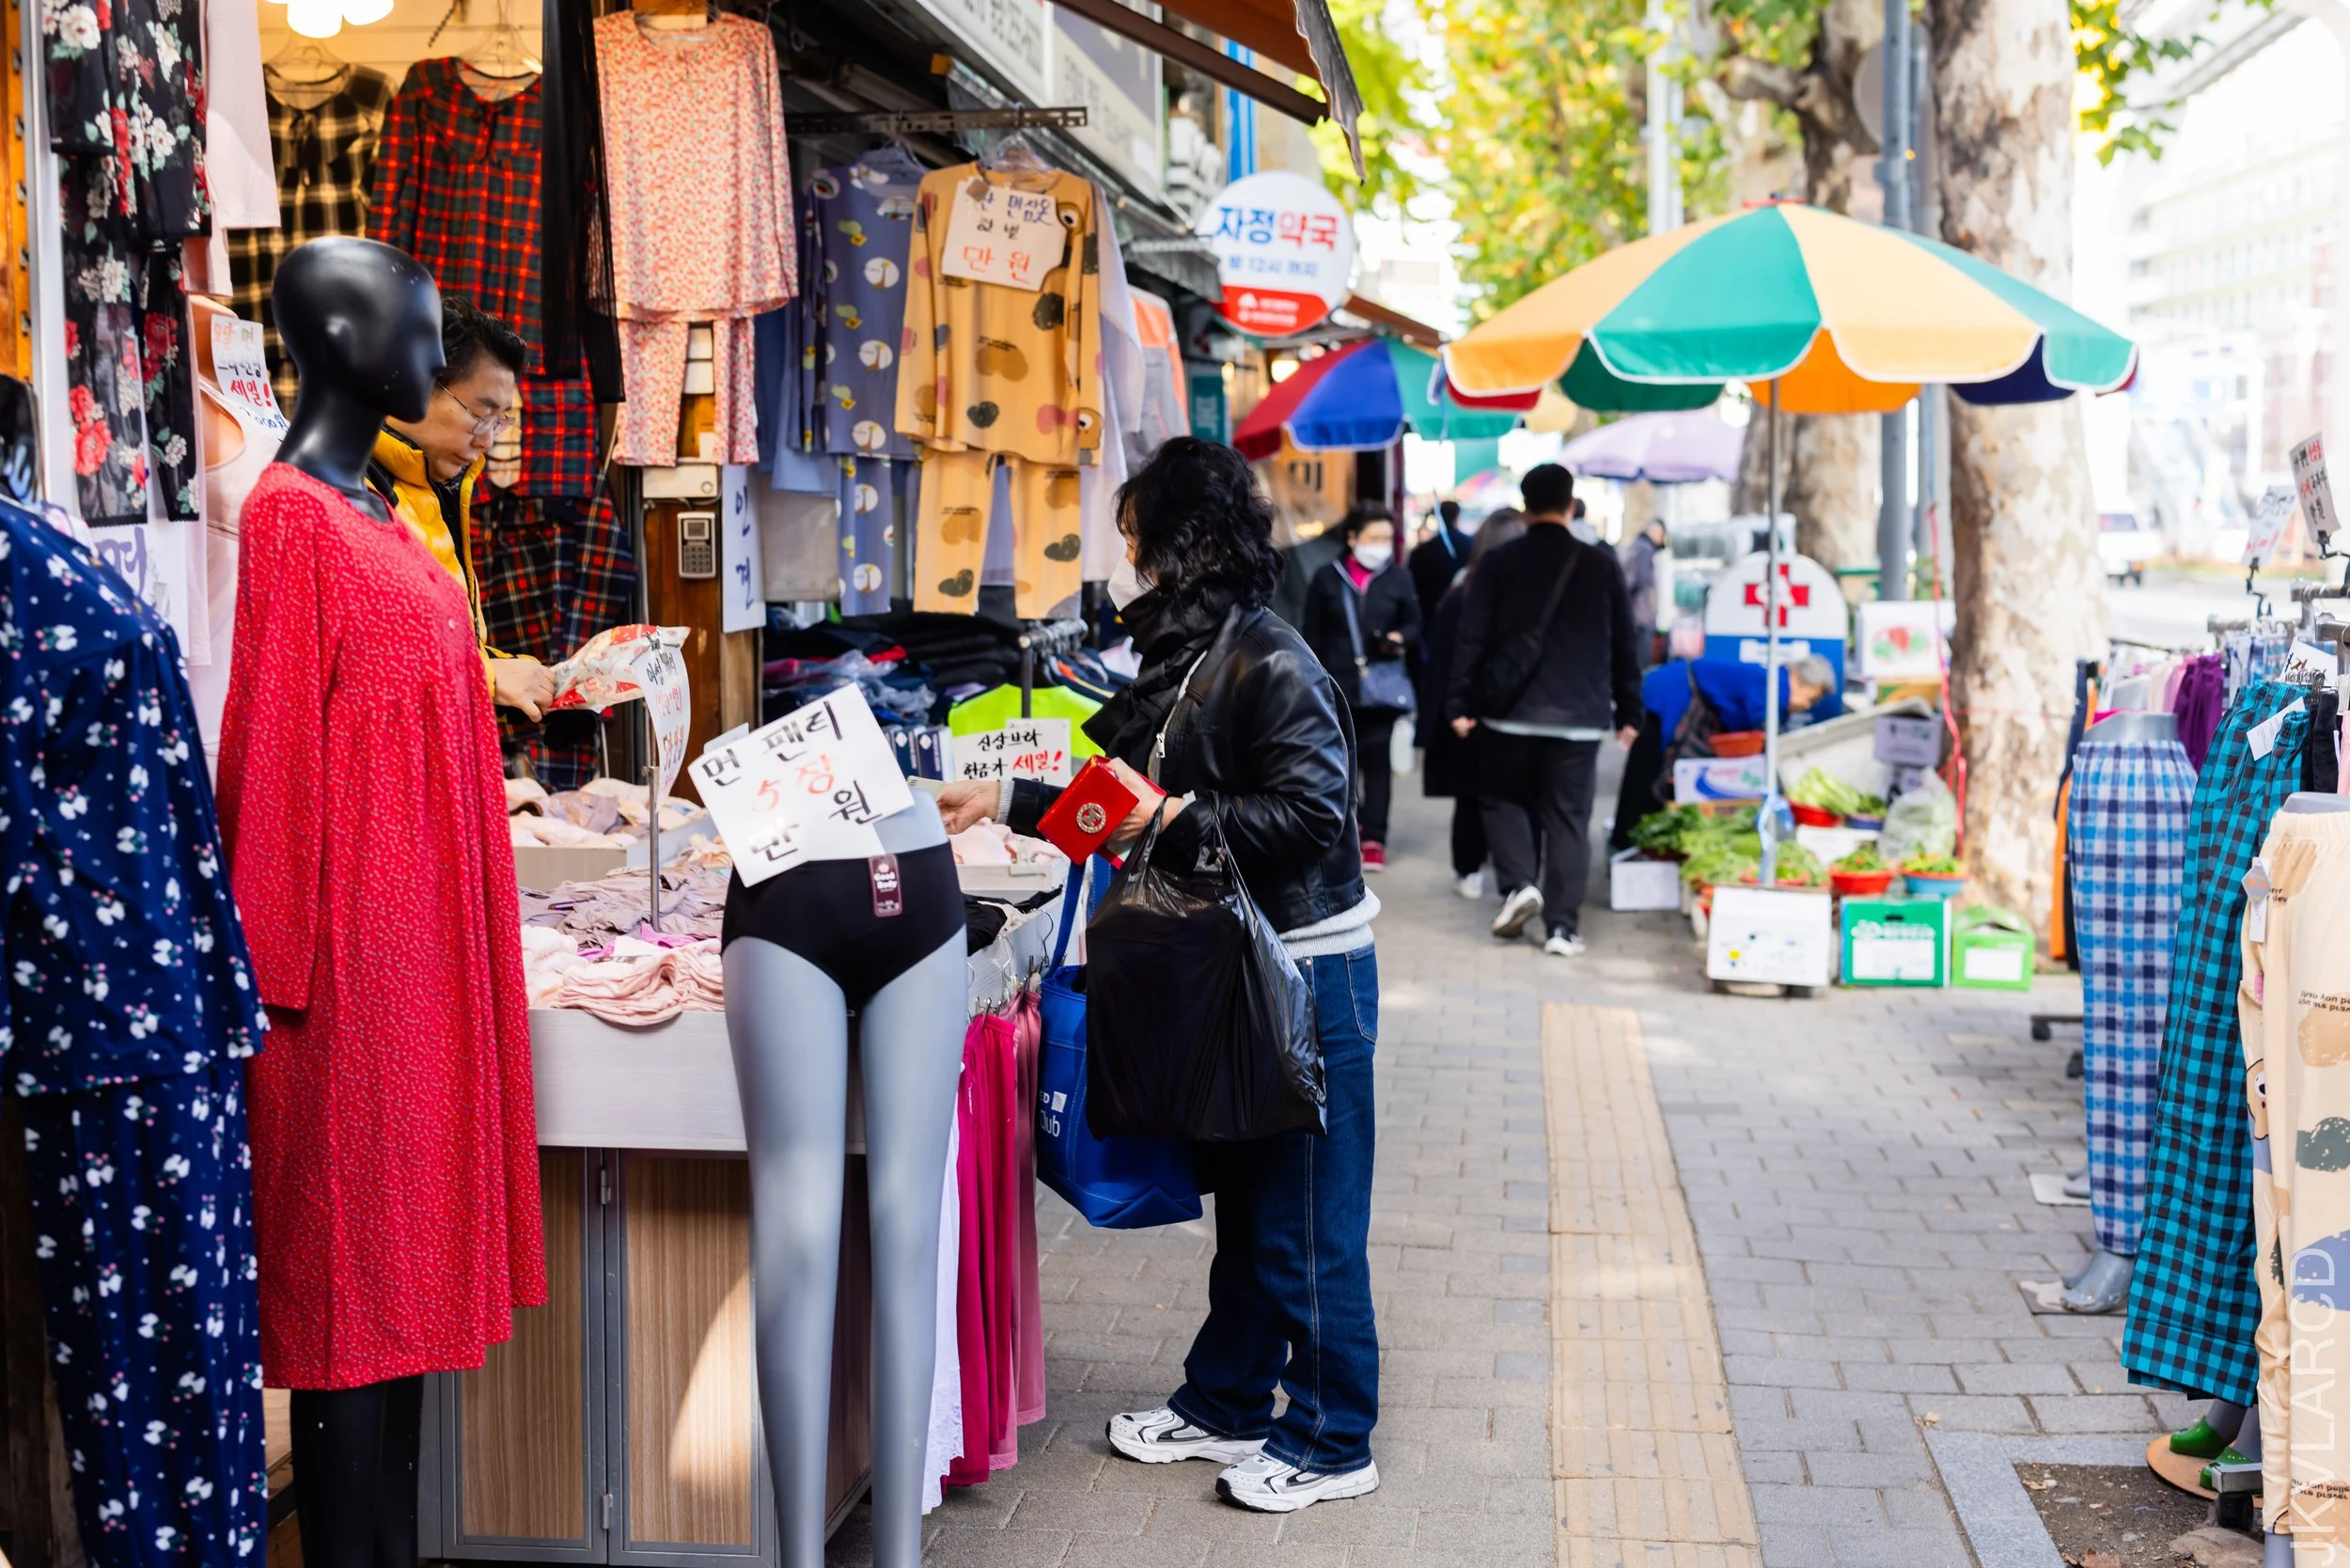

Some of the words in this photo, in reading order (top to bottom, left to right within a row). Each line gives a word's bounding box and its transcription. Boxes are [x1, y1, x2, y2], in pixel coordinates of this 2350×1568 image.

[1216, 207, 1339, 251] 자정약국
[230, 379, 273, 407] 세일!
[701, 748, 742, 787] 면
[761, 700, 842, 761] 팬티
[1012, 750, 1062, 774] 세일!
